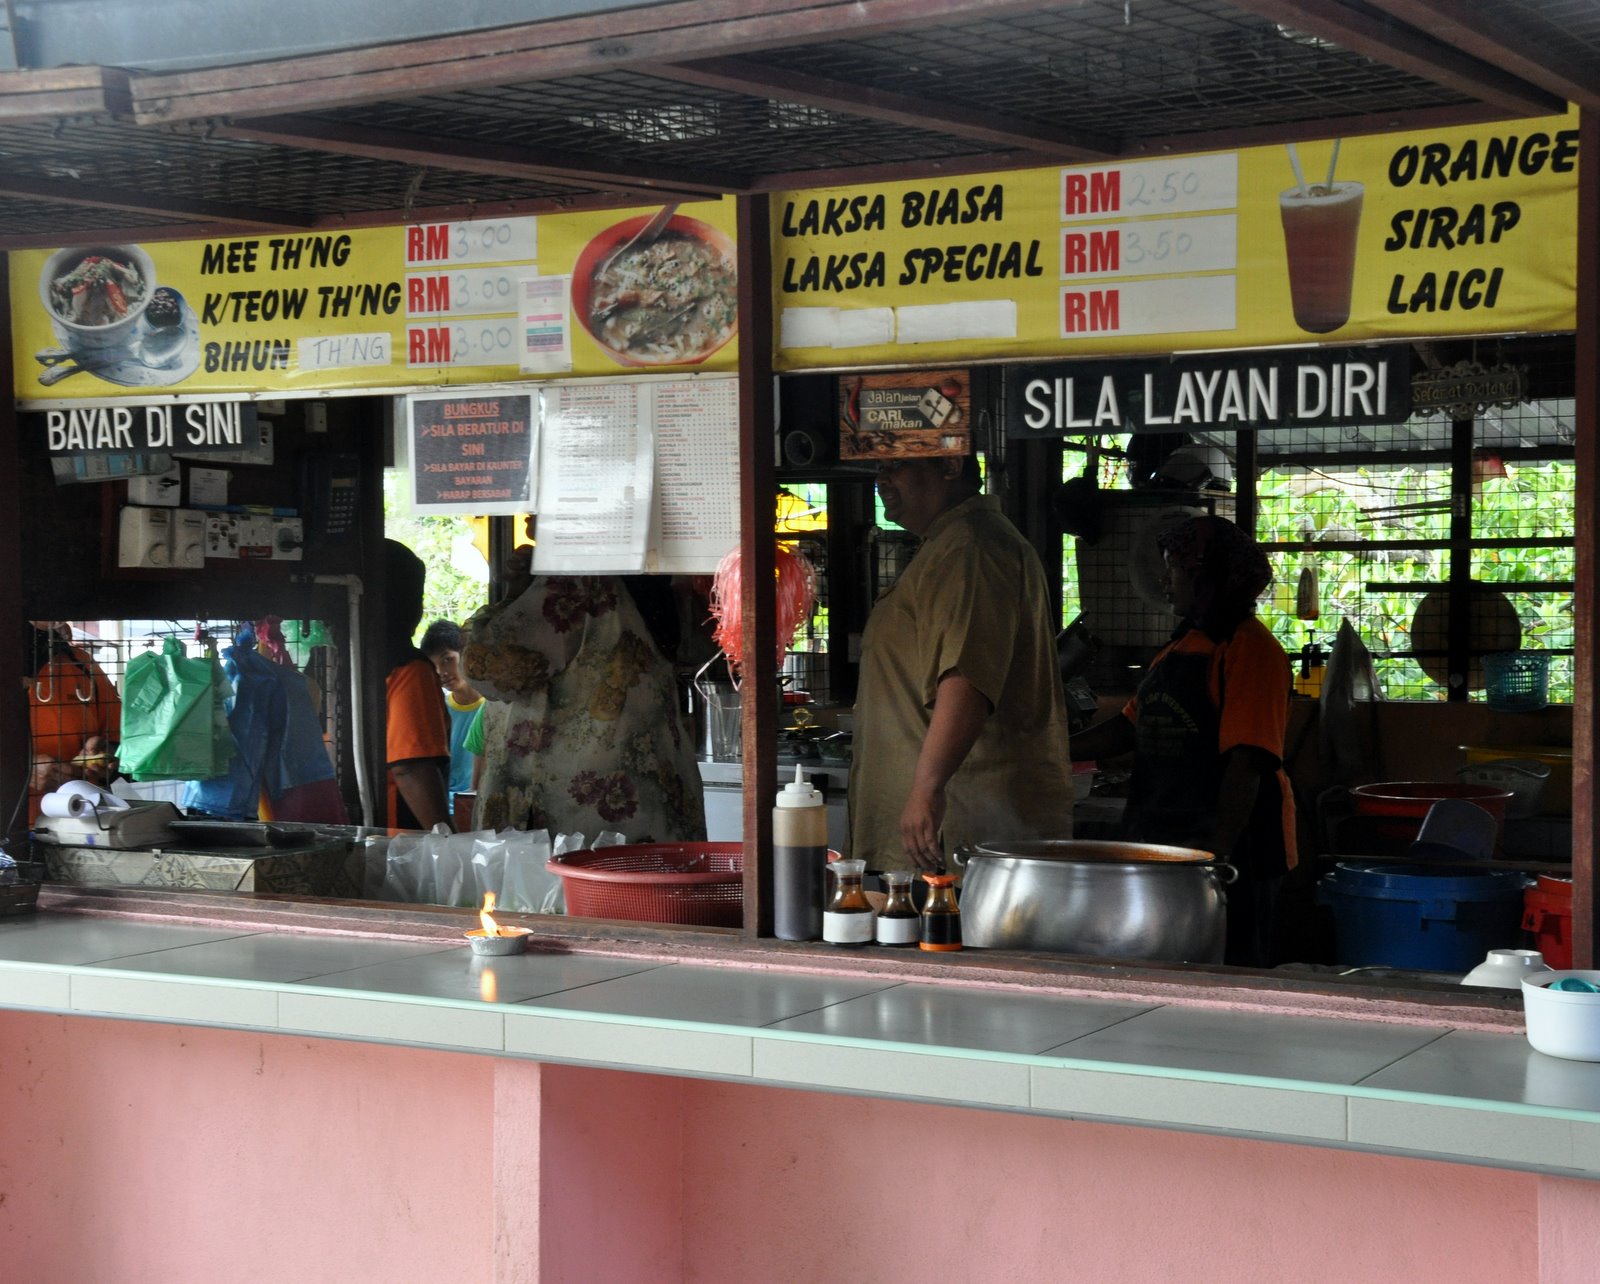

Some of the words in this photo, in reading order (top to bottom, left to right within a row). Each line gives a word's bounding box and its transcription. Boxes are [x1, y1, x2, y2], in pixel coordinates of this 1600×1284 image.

[1388, 129, 1579, 187] ORANGE
[781, 193, 885, 238] LAKSA
[902, 184, 1004, 229] BIASA
[1065, 171, 1121, 215] RM
[1126, 171, 1201, 207] 2.50
[408, 224, 449, 261] RM
[453, 223, 512, 259] 3.00
[1385, 200, 1521, 252] SIRAP
[200, 242, 258, 275] MEE
[268, 233, 352, 271] TH'NG
[781, 251, 885, 294] LAKSA
[899, 240, 1044, 286] SPECIAL
[1065, 229, 1121, 274] RM
[1125, 230, 1193, 265] 3.50
[201, 286, 308, 327] K/TEOW
[317, 282, 402, 319] TH'NG
[408, 275, 450, 312] RM
[453, 274, 511, 308] 3.00
[1065, 288, 1121, 333] RM
[1387, 267, 1505, 315] LAICI
[204, 338, 292, 373] BIHUN
[312, 336, 385, 365] TH'NG
[408, 327, 451, 364] RM
[456, 326, 512, 358] 3.00
[443, 401, 500, 418] BUNGKUS
[867, 390, 901, 404] Jalan
[901, 394, 922, 404] jalan
[868, 409, 902, 422] CARI
[1023, 374, 1120, 431] SILA
[1142, 366, 1279, 426] LAYAN
[1295, 362, 1389, 421] DIRI
[47, 406, 134, 451] BAYAR
[147, 405, 173, 448] DI
[186, 402, 243, 446] SINI
[431, 424, 455, 437] SILA
[458, 421, 509, 436] BERATUR
[512, 420, 524, 433] DI
[881, 418, 923, 430] makan
[430, 463, 447, 473] SILA
[477, 461, 486, 471] DI
[461, 443, 485, 456] SINI
